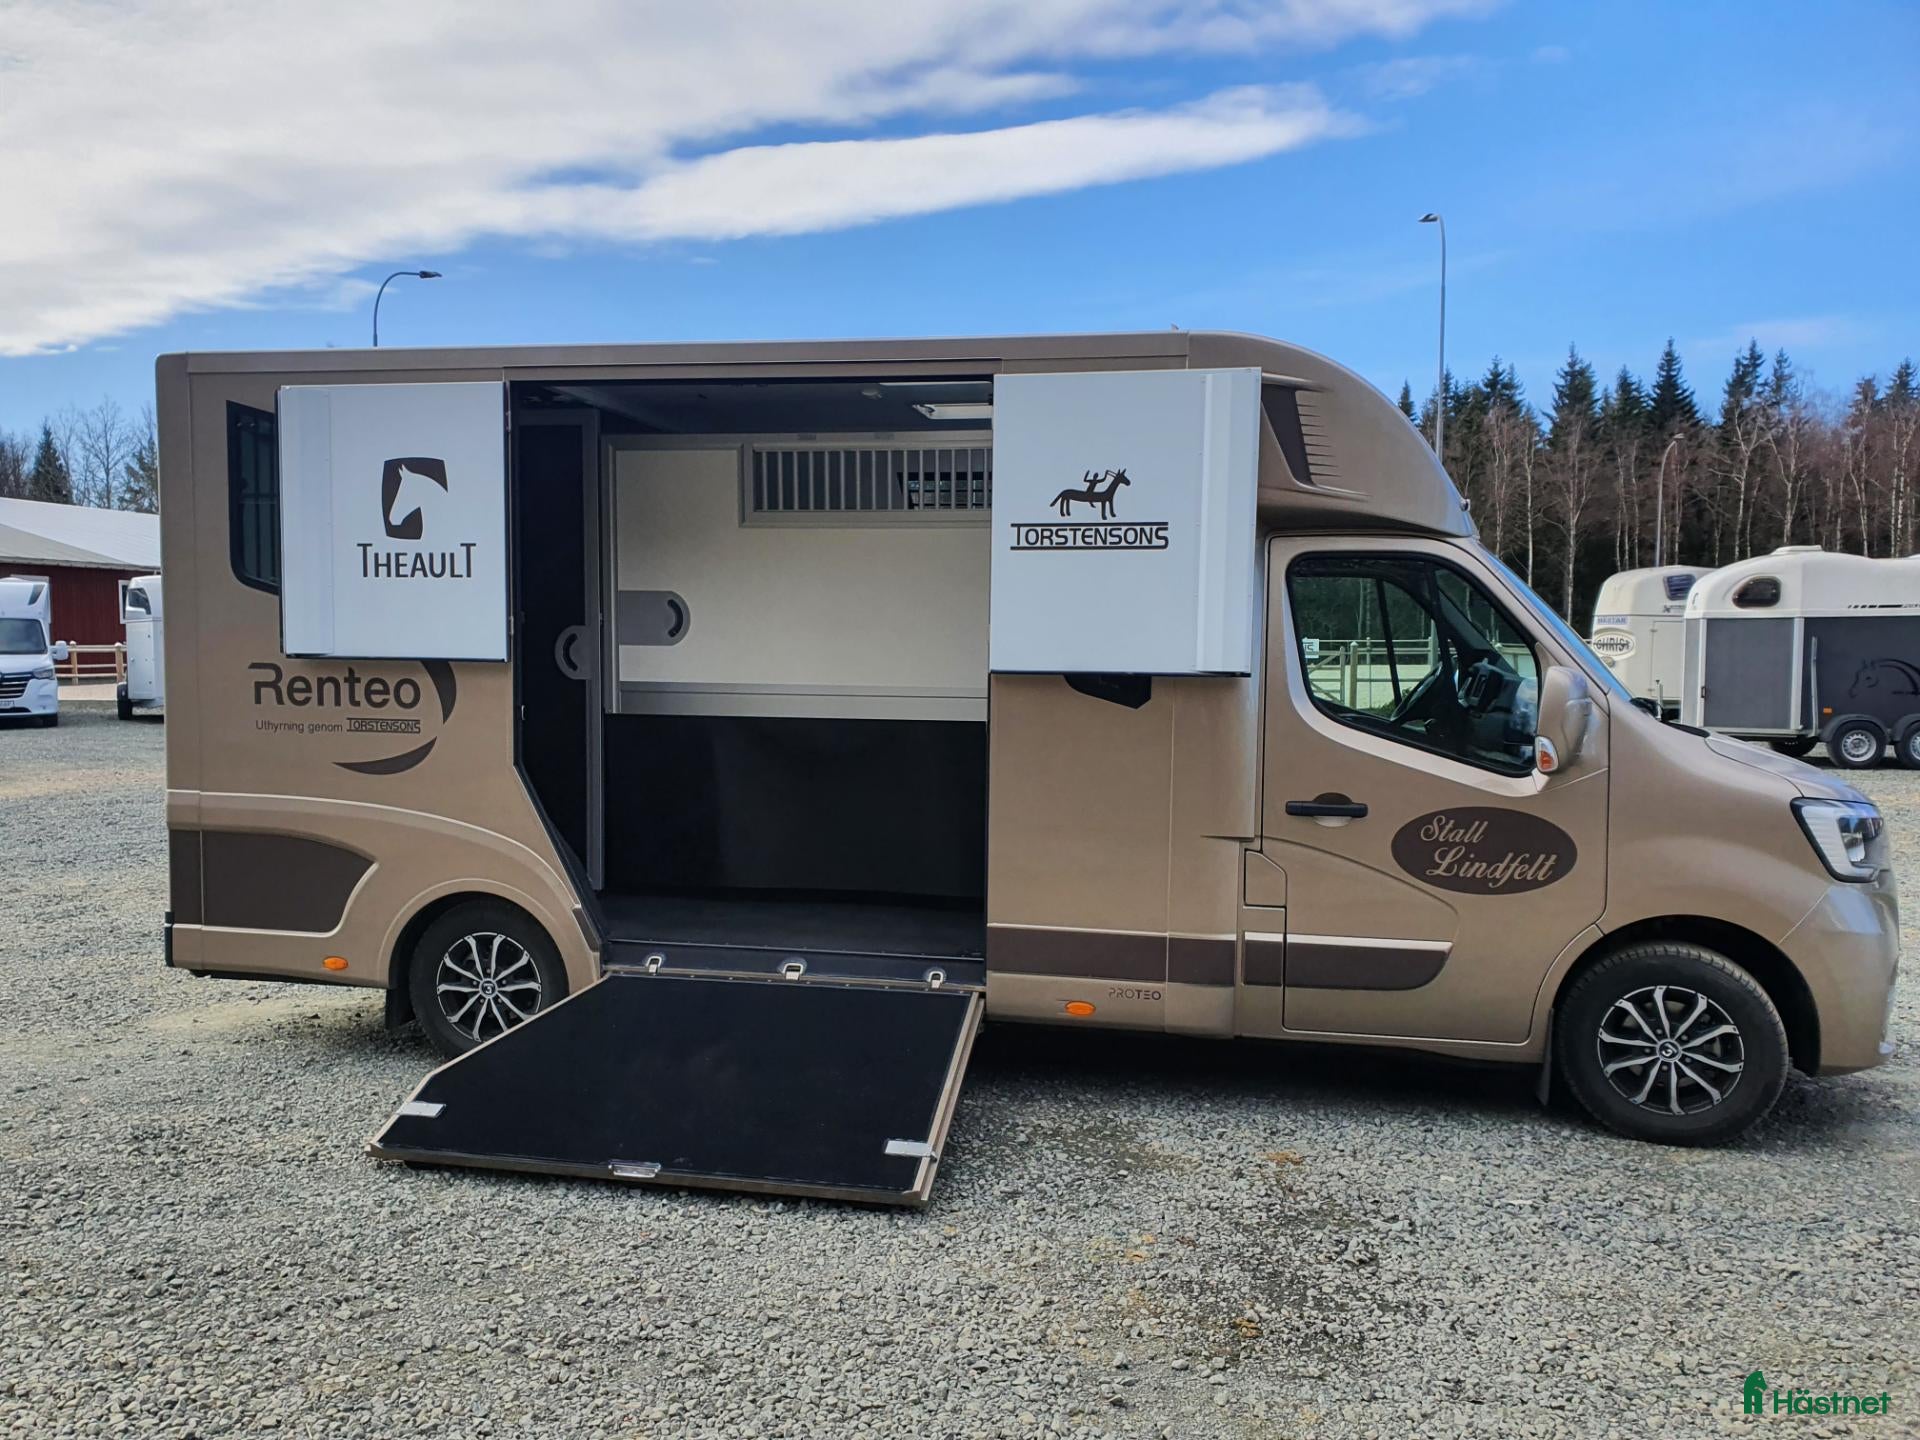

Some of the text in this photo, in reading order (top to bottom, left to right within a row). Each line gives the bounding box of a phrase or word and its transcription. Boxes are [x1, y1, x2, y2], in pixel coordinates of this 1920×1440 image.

[1010, 522, 1169, 550] TORSTENSONS
[356, 543, 477, 578] THEAULT
[248, 662, 421, 709] Renteo
[255, 717, 421, 734] Uthyrning genom TORSTENSONS
[1420, 815, 1489, 843] Stall
[1425, 845, 1557, 889] Lindfelt
[1108, 987, 1162, 1001] PROTEO
